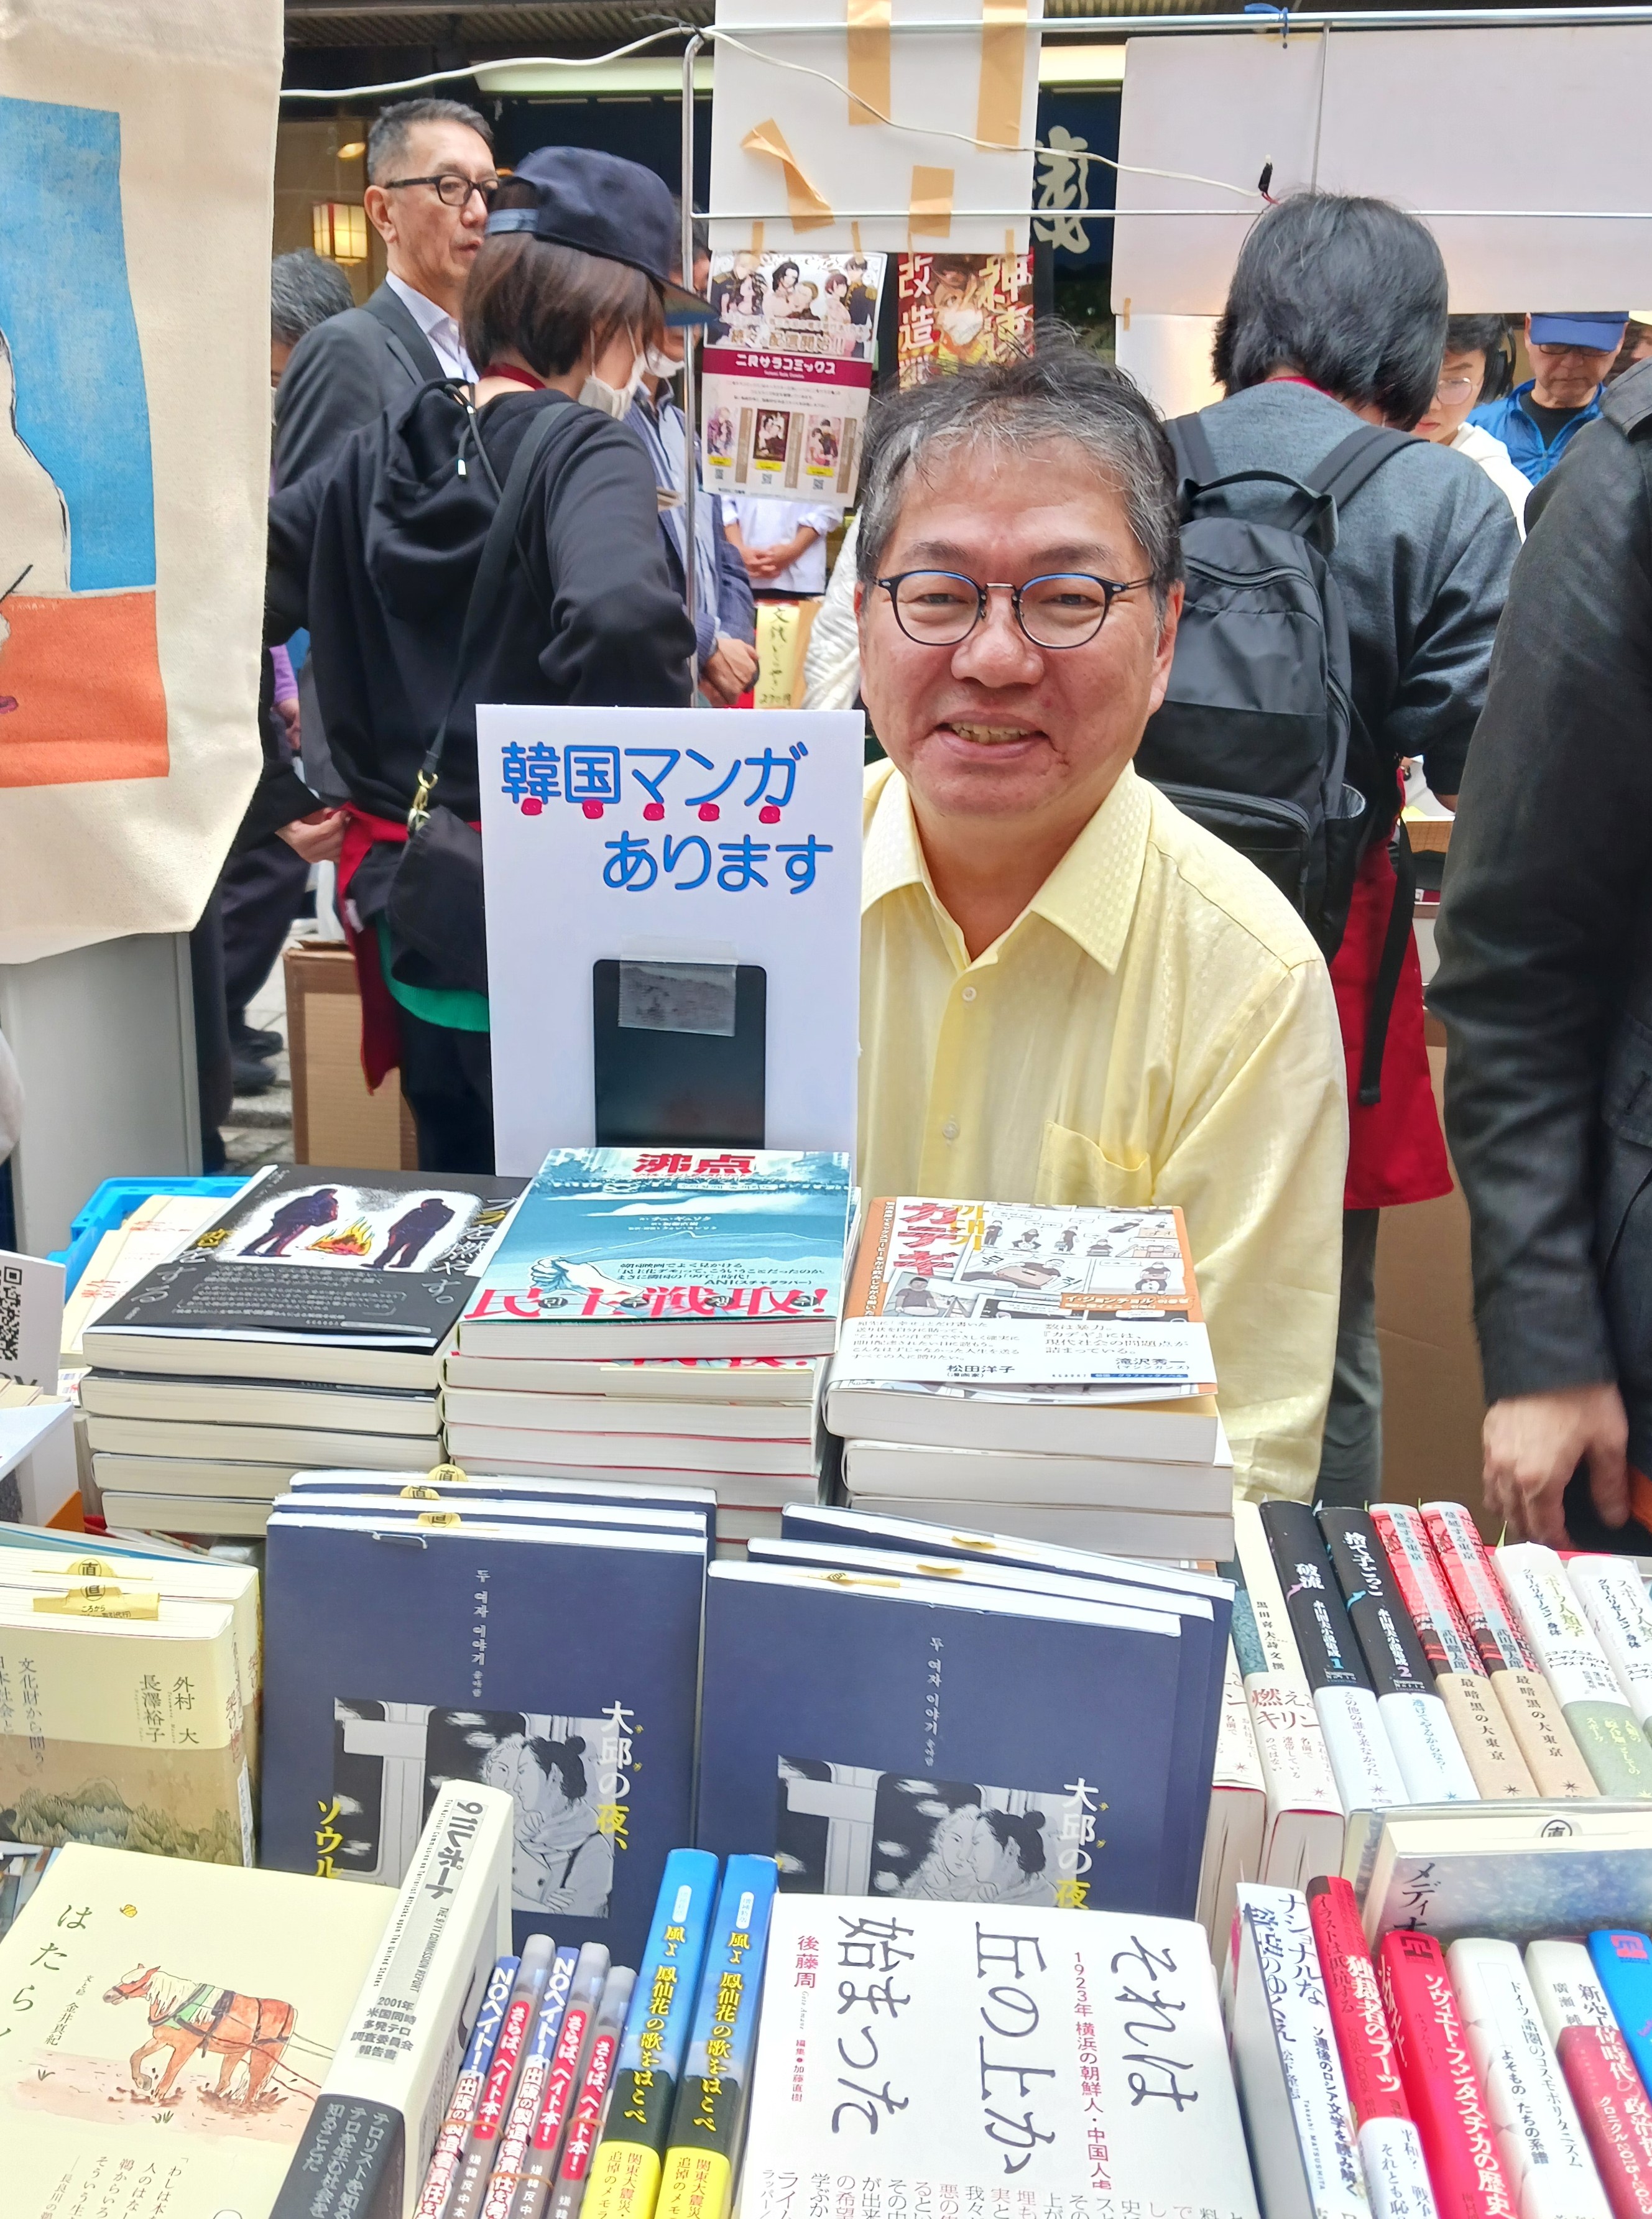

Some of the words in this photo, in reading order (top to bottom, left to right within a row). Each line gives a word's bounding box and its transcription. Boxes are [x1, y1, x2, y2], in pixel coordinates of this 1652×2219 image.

[898, 256, 934, 353] 改造
[501, 741, 809, 806] 韓国マンガ
[602, 830, 833, 894] あります
[633, 1153, 755, 1174] 沸点
[893, 1202, 959, 1276] カデギ
[946, 1364, 1015, 1373] 松田洋子
[1045, 1339, 1189, 1347] 現代社会の問題点が
[1045, 1347, 1137, 1355] 詰まっている。
[1115, 1357, 1186, 1365] 滝沢秀一
[473, 1590, 489, 1619] 여자
[475, 1569, 491, 1583] 두
[1543, 1571, 1585, 1637] ポーツ人類学
[81, 1605, 106, 1613] ころから
[471, 1623, 488, 1666] 이야기
[926, 1658, 942, 1688] 여자
[930, 1636, 944, 1652] 두
[139, 1674, 165, 1743] 長澤裕子
[172, 1676, 195, 1710] 外村
[924, 1692, 940, 1736] 이야기
[1256, 1710, 1320, 1730] キリン
[1460, 1678, 1506, 1761] 最暗黒の大東京
[1516, 1675, 1564, 1757] 最暗黒の大東京
[178, 1728, 200, 1745] 大
[596, 1700, 635, 1850] 大邱の夜、
[313, 1800, 344, 1879] ソウル
[1054, 1777, 1099, 1910] 大邱の夜
[421, 1931, 440, 1970] COMMISSION
[663, 1924, 686, 1957] 風よ
[727, 1931, 751, 1964] 風よ
[793, 1935, 819, 1989] 後藤周
[1278, 1893, 1326, 2008] ナショナルな
[1319, 1896, 1355, 2014] イラストは抵抗する
[377, 1996, 415, 2012] 2001年
[410, 1968, 427, 1993] REPORT
[535, 1957, 576, 2055] NOヘイト!
[1074, 1951, 1094, 2018] 1923年
[44, 2001, 80, 2046] 金井真紀
[350, 2031, 414, 2052] 調査委員会
[362, 2019, 412, 2037] 多発テロ
[366, 2006, 417, 2025] 米国同時
[471, 1967, 515, 2072] NOヘイト!
[624, 1964, 678, 2124] 鳳仙花の歌をはこべ
[831, 1916, 915, 2135] 始まった
[1110, 1935, 1199, 2113] それは
[1345, 1955, 1402, 2093] 独裁者のブーツ
[358, 2044, 398, 2061] 報告書
[479, 2004, 526, 2132] さらば、ヘイト本!
[538, 2014, 583, 2143] さらば、ヘイト本!
[693, 1972, 744, 2132] 鳳仙花の歌をはこべ
[975, 1921, 1056, 2174] 丘の上から
[1511, 1981, 1584, 2169] ドイツ語圏のコスモポリタニズム
[566, 2040, 611, 2172] さらば、ヘイト本!
[1313, 2026, 1358, 2197] ソ連後のロシア文学を読み解く
[1424, 1973, 1518, 2219] ソヴィエト・ファンタスチカの歴史
[415, 2078, 478, 2219] 出版の製造者責任を
[1309, 2134, 1326, 2190] MATSUSHITA
[69, 2156, 109, 2219] そういう生
[149, 2156, 189, 2219] 「わしは本
[453, 2153, 482, 2219] 嫌韓反中本
[519, 2164, 543, 2219] 嫌韓反中
[668, 2157, 691, 2219] 追悼のメモ
[810, 2172, 831, 2218] 学ぶか
[938, 2184, 959, 2219] 悪の
[964, 2185, 985, 2219] 我々
[1121, 2200, 1142, 2219] 史
[1382, 2144, 1410, 2219] それとも恥
